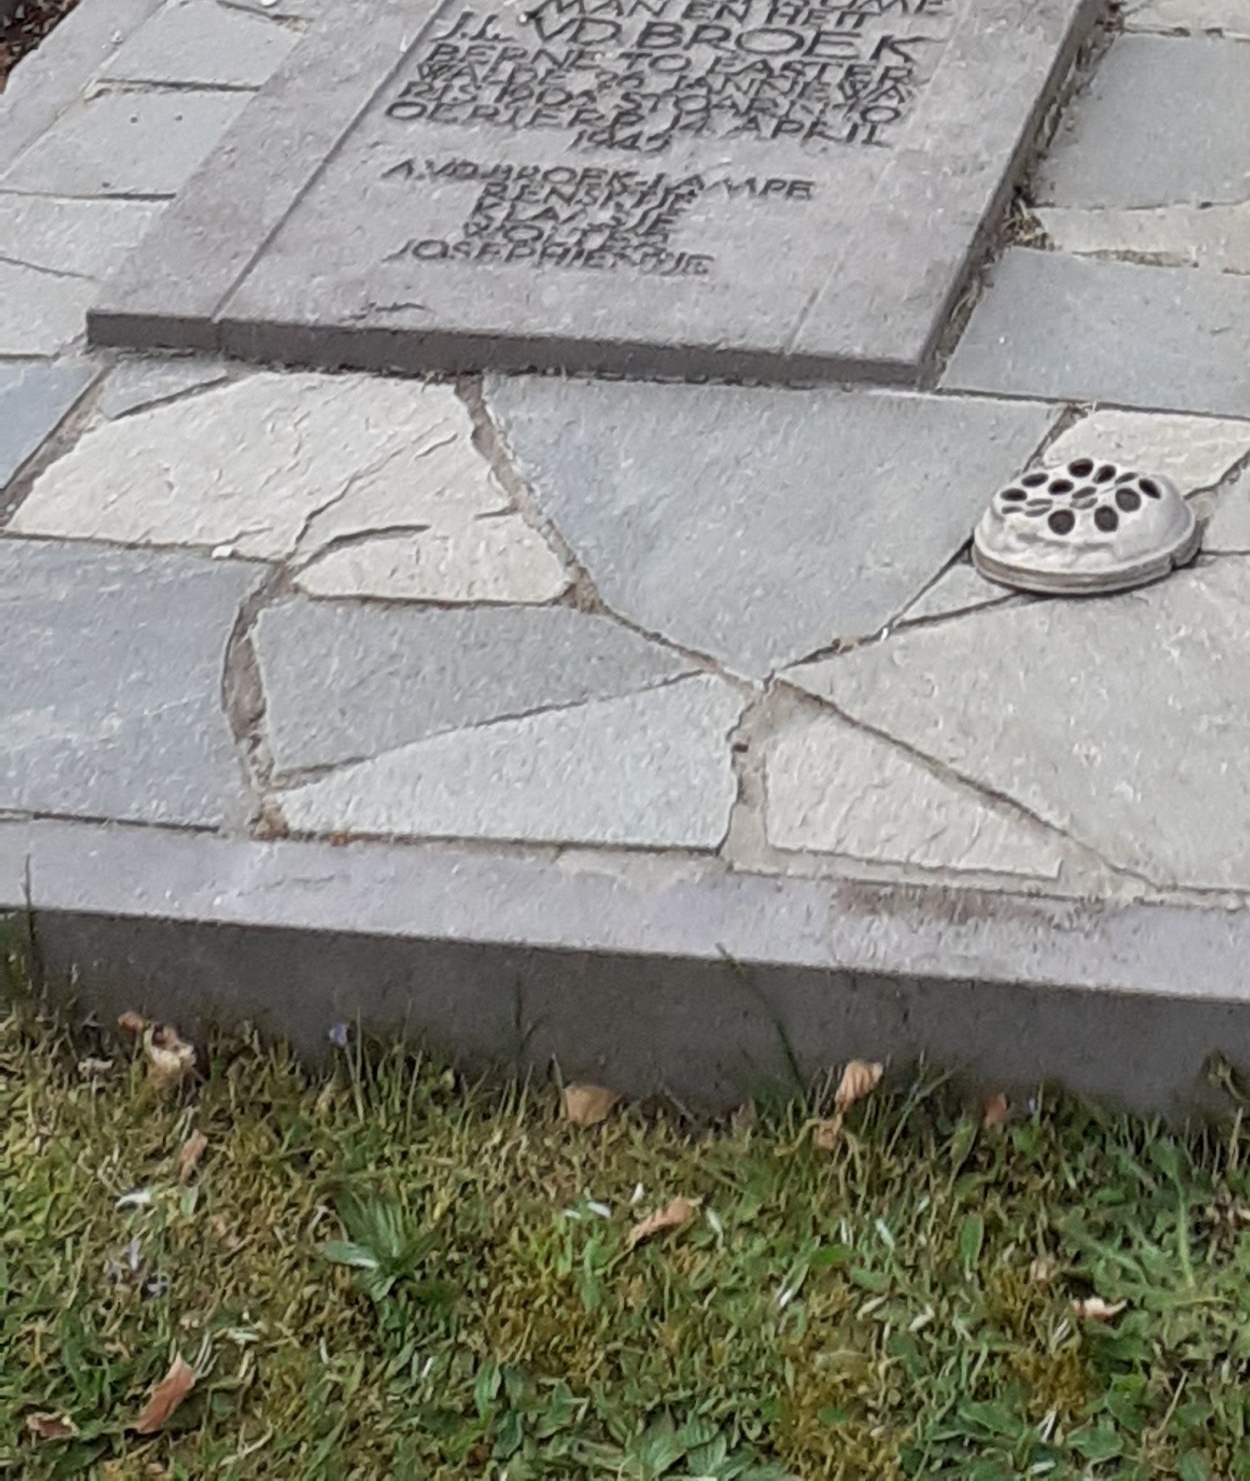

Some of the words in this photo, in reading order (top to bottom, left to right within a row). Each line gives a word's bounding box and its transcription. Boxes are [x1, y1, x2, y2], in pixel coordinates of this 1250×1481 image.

[679, 2, 752, 22] EN
[631, 22, 950, 64] BROEK
[425, 43, 605, 69] BERNE
[612, 52, 694, 73] TO
[729, 117, 895, 146] APRIL
